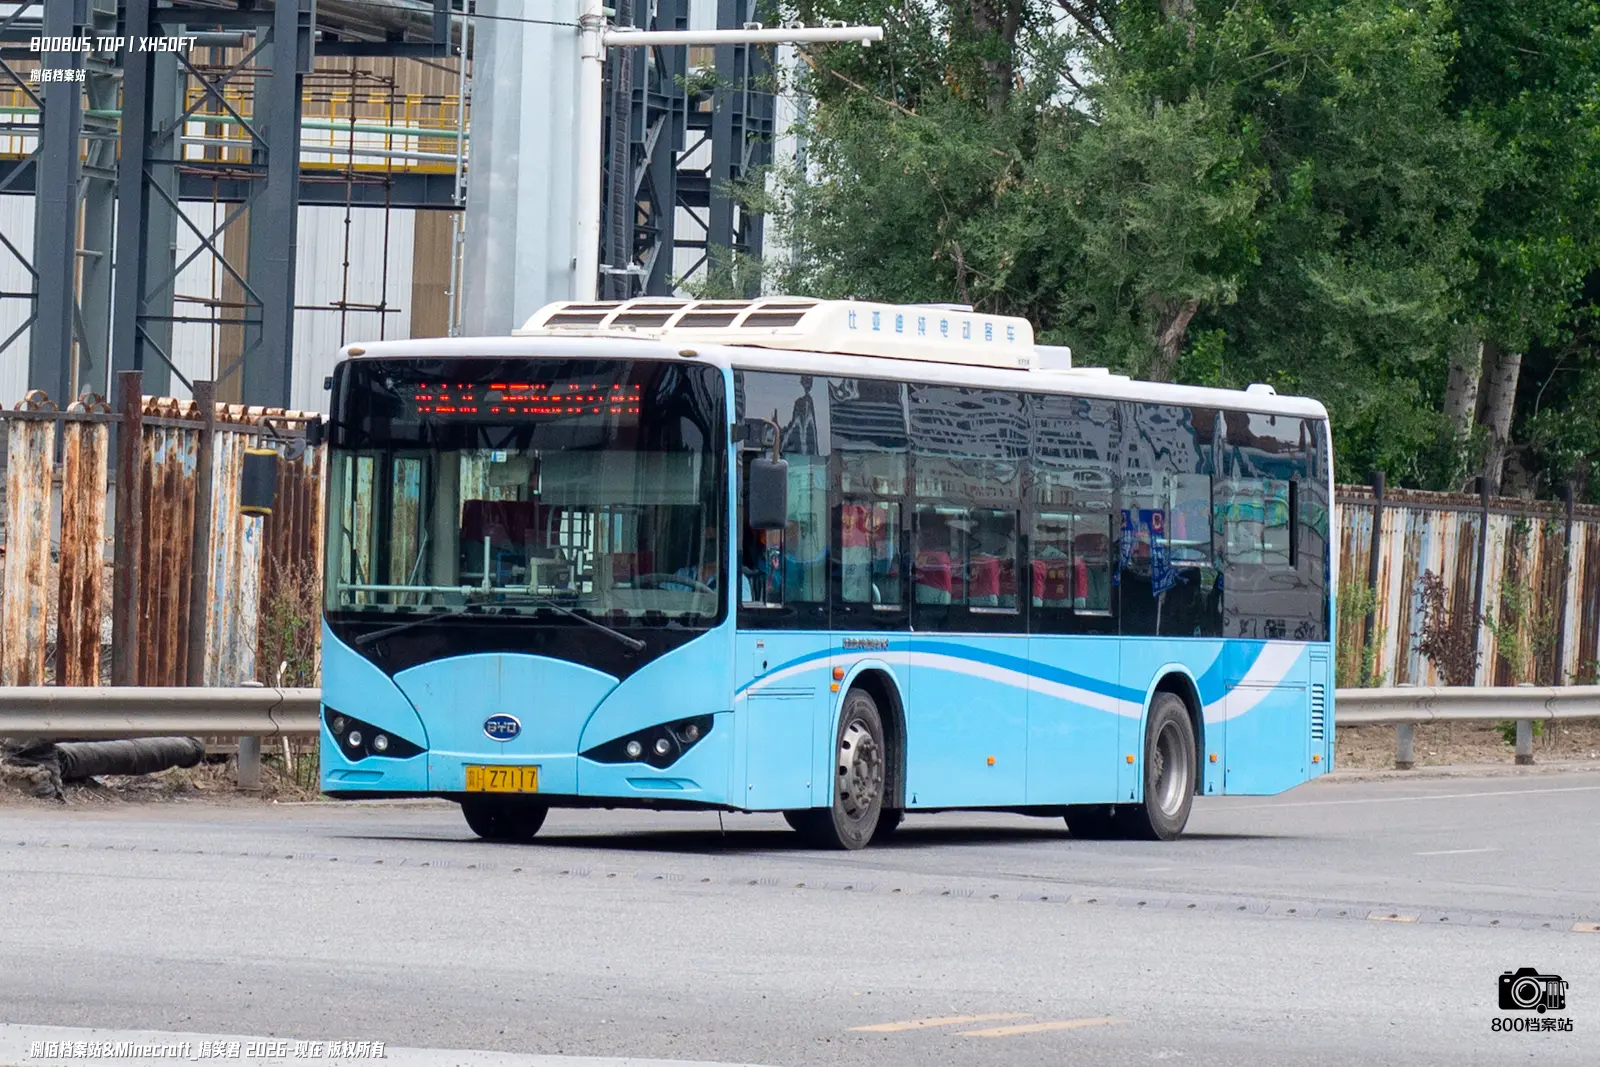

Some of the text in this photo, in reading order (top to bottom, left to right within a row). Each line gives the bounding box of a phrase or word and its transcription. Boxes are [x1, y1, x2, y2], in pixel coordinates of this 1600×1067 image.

[848, 310, 1015, 343] 比亚迪纯电动客车
[487, 721, 517, 733] BYD
